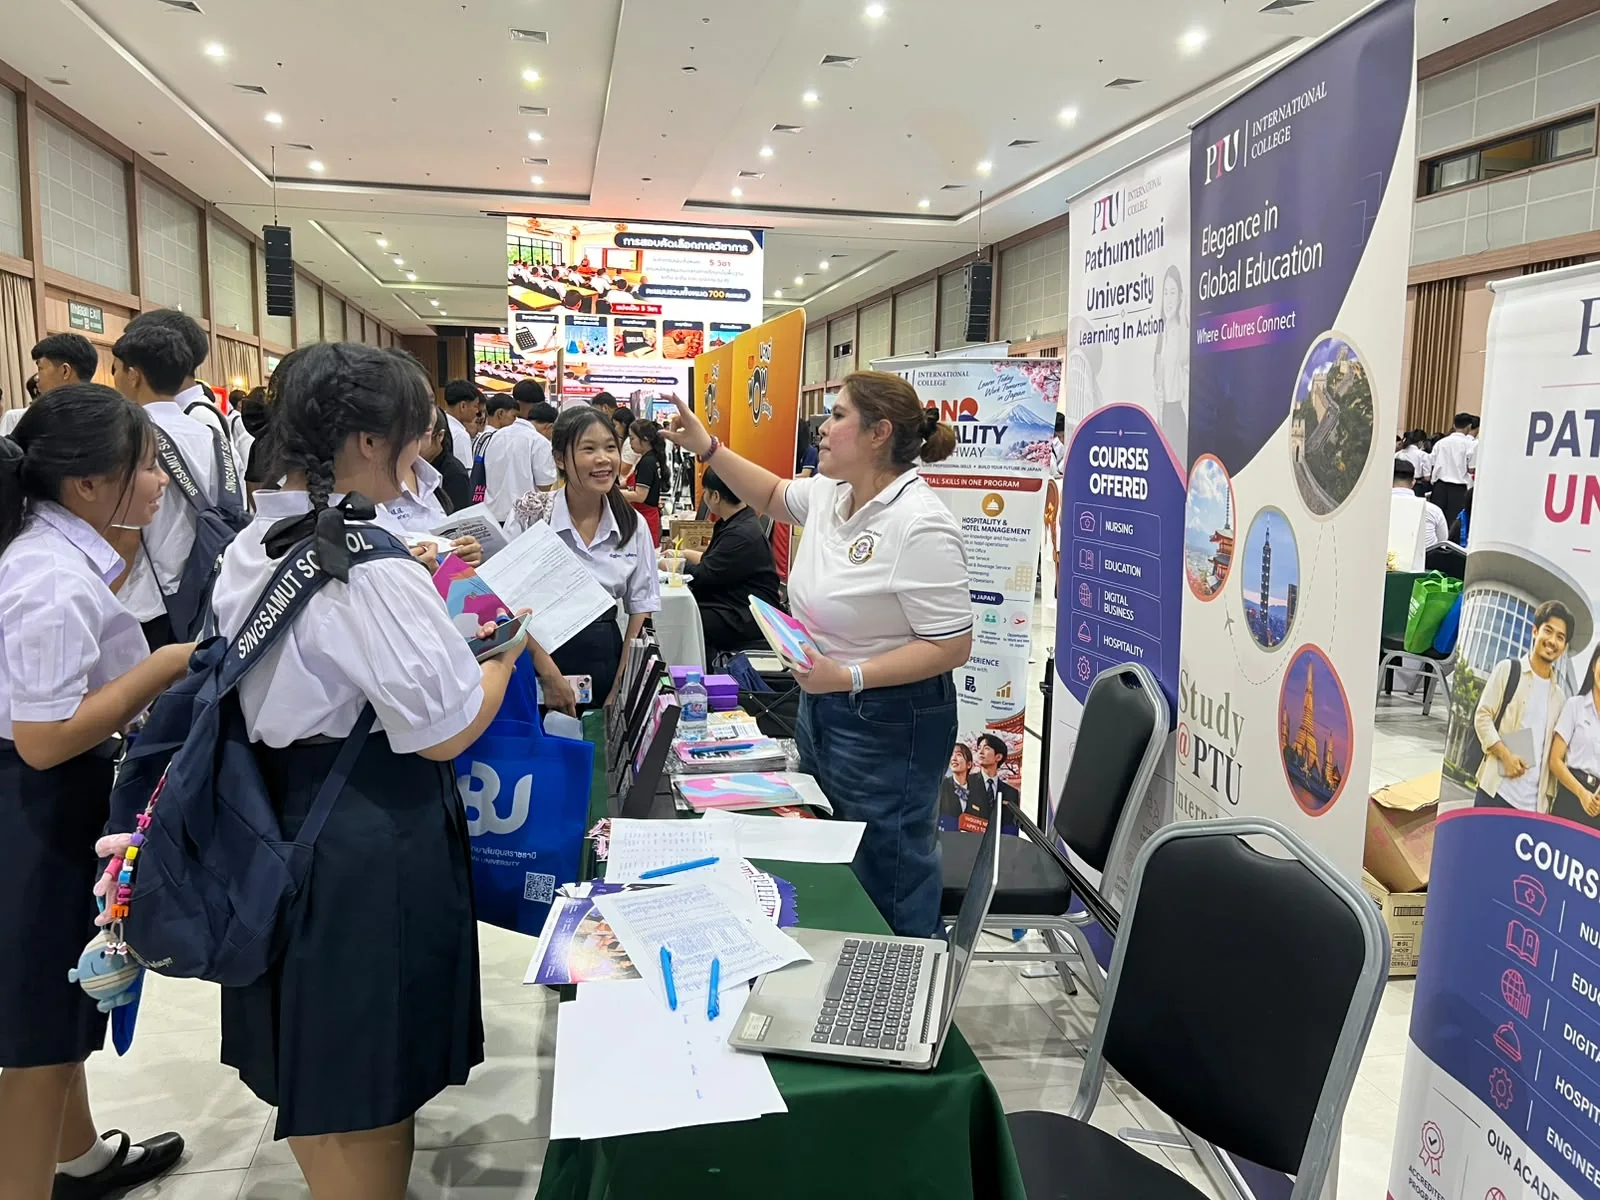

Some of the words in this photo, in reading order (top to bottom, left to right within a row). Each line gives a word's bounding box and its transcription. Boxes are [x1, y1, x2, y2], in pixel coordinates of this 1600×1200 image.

[1205, 129, 1239, 185] PTU
[1252, 81, 1327, 137] INTERNATIONAL
[1251, 126, 1291, 159] COLLEGE
[1092, 191, 1119, 235] PTU
[1128, 176, 1162, 202] INTERNATIONAL
[1128, 199, 1148, 216] COLLEGE
[1202, 213, 1260, 258] Elegance
[1264, 200, 1278, 232] in
[1085, 217, 1164, 273] Pathumthani
[1199, 259, 1241, 300] Global
[1246, 239, 1323, 289] Education
[709, 290, 725, 298] 700
[1086, 272, 1154, 311] University
[1080, 324, 1119, 346] Learning
[1123, 322, 1134, 339] In
[1136, 314, 1164, 338] Action
[1197, 328, 1219, 344] Where
[1221, 322, 1254, 339] Cultures
[1257, 311, 1296, 333] Connect
[918, 370, 969, 378] INTERNATIONAL
[978, 380, 995, 390] Learn
[998, 374, 1014, 384] Today
[985, 387, 1001, 397] Work
[1003, 382, 1027, 391] Tomorrow
[1004, 390, 1026, 401] Japan
[1089, 445, 1149, 471] COURSES
[984, 480, 1020, 488] PROGRAM
[1090, 473, 1148, 500] OFFERED
[962, 517, 1001, 526] HOSPITALITY
[981, 526, 1031, 535] MANAGEMENT
[1105, 520, 1133, 535] NURSING
[1104, 559, 1141, 577] EDUCATION
[238, 570, 302, 659] SINGSAMUT
[296, 532, 374, 579] SCOL
[1104, 591, 1128, 606] DIGITAL
[1104, 603, 1134, 620] BUSINESS
[1104, 635, 1144, 658] HOSPITALITY
[1179, 669, 1244, 758] Study
[1515, 832, 1600, 903] COURS
[1580, 922, 1600, 949] NU
[1555, 1074, 1600, 1127] HOSPIT
[1487, 1129, 1511, 1165] OUR
